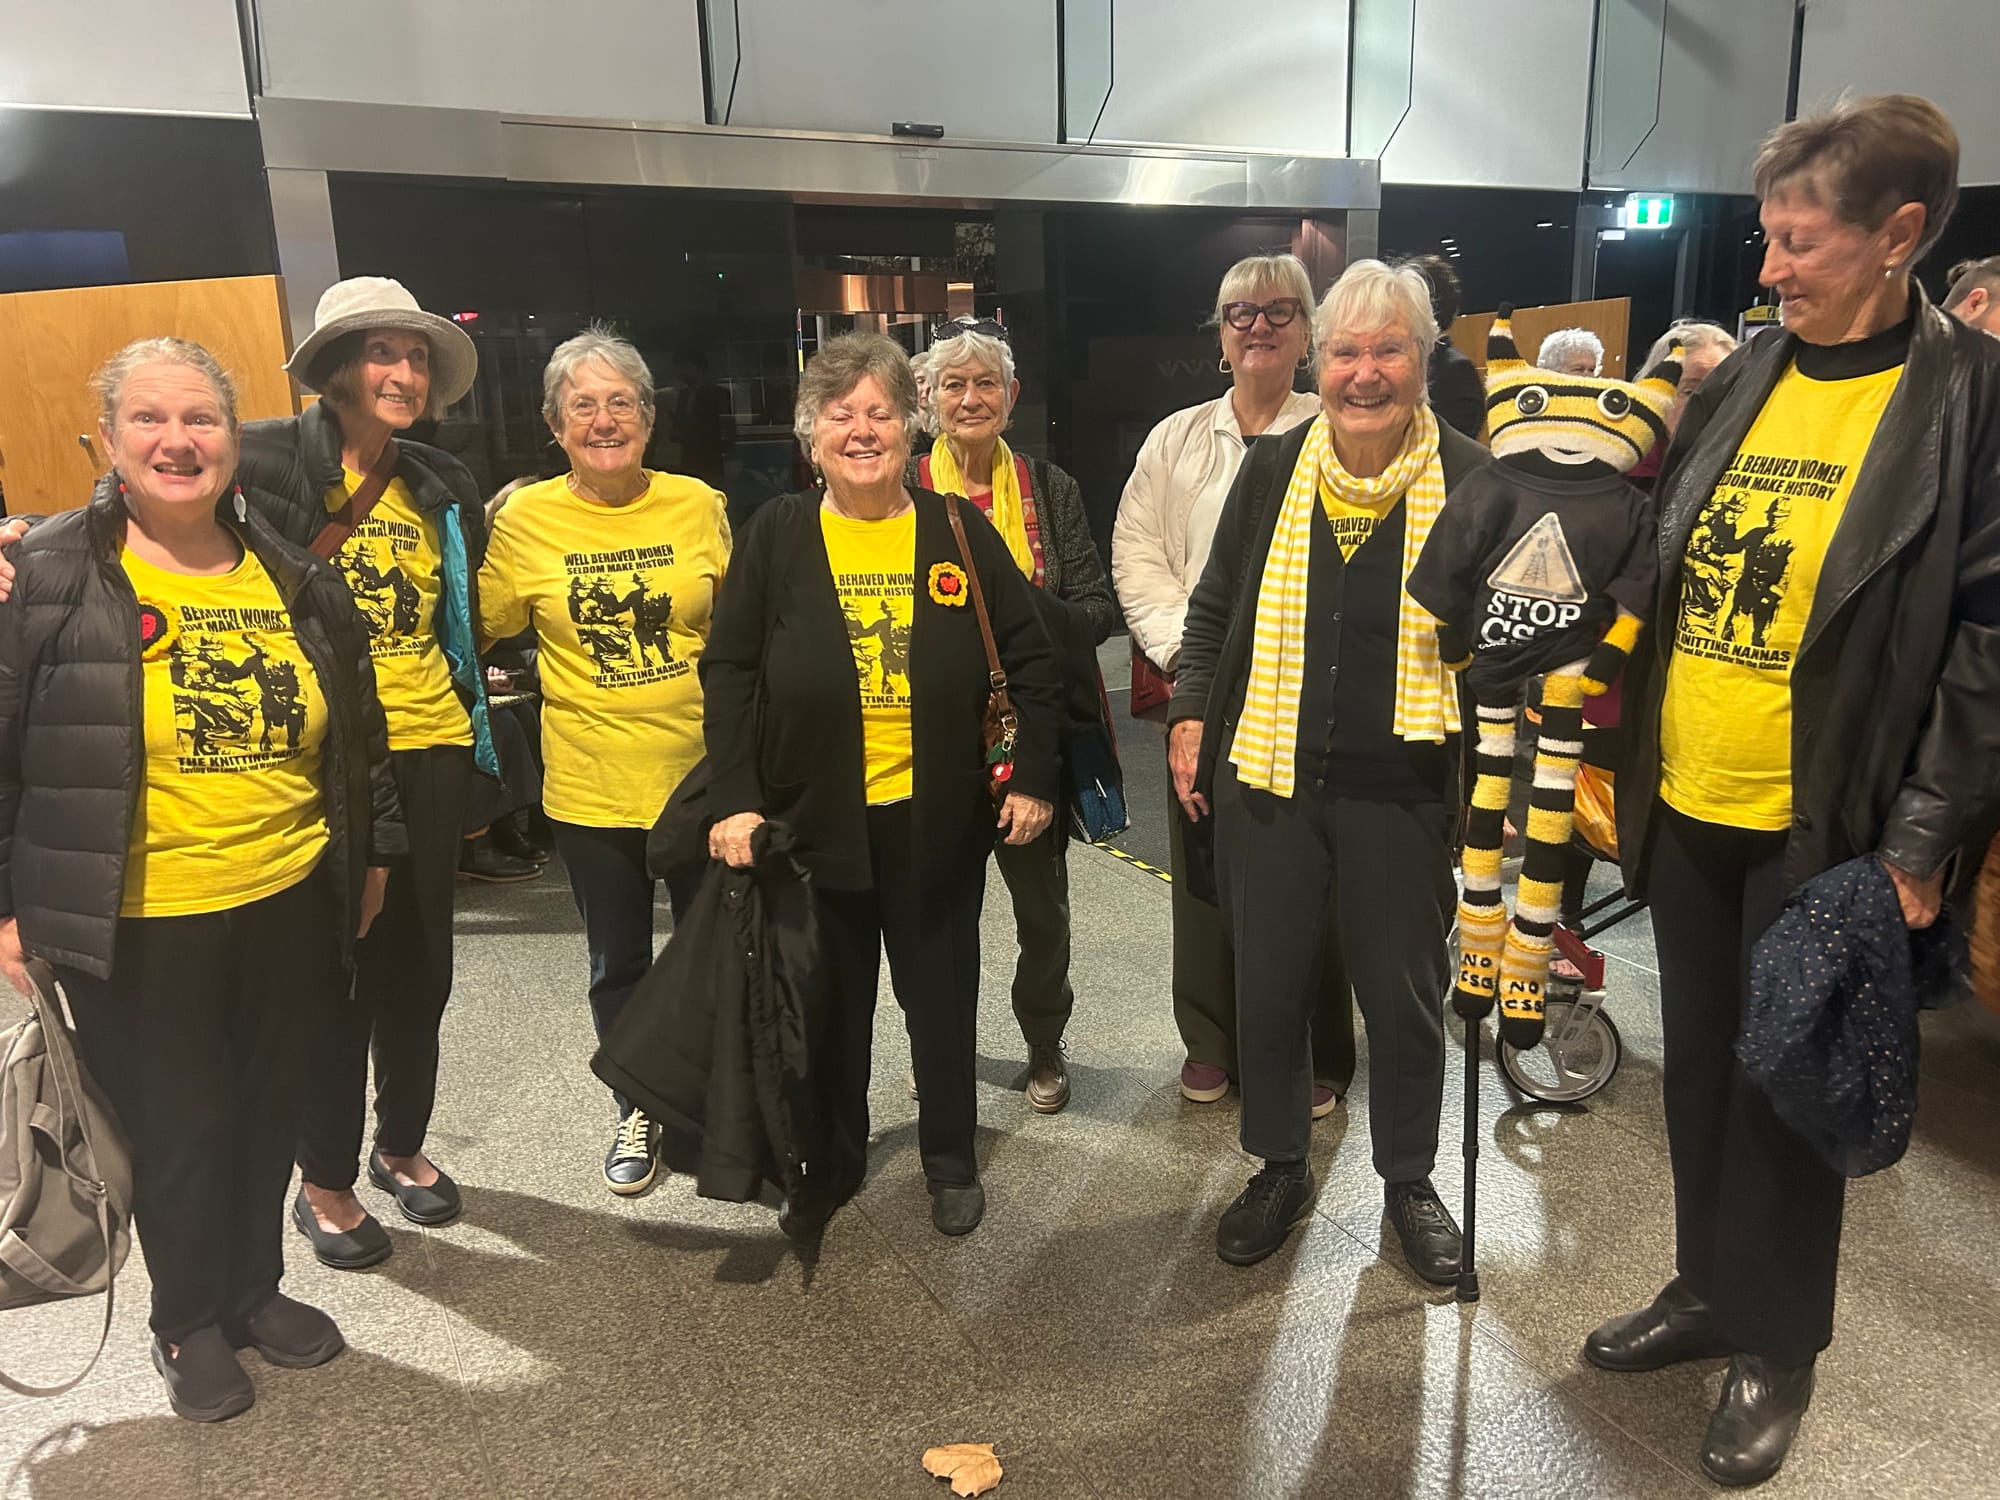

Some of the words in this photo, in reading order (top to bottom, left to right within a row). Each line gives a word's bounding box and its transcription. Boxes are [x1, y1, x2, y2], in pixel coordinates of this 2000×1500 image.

[1743, 455, 1799, 478] BEHAVED
[1797, 459, 1848, 485] WOMEN
[1751, 477, 1786, 493] MAKE
[1784, 481, 1838, 501] HISTORY
[388, 521, 421, 541] WOMEN
[391, 538, 418, 553] STORY
[564, 553, 590, 567] WELL
[590, 549, 636, 564] BEHAVED
[636, 544, 674, 561] WOMEN
[566, 565, 605, 576] SELDOM
[607, 562, 634, 573] MAKE
[635, 557, 675, 570] HISTORY
[838, 573, 884, 587] BEHAVED
[886, 573, 914, 586] WOM
[854, 588, 882, 597] MAKE
[884, 587, 914, 597] HISTO
[1487, 591, 1581, 629] STOP
[1731, 644, 1791, 663] NANNAS
[610, 668, 655, 682] KNITTING
[656, 660, 689, 675] NANNAS
[861, 696, 894, 704] TING
[177, 756, 206, 767] THE
[209, 750, 269, 767] KNITTING
[1463, 953, 1492, 968] NO
[1509, 980, 1540, 995] NO
